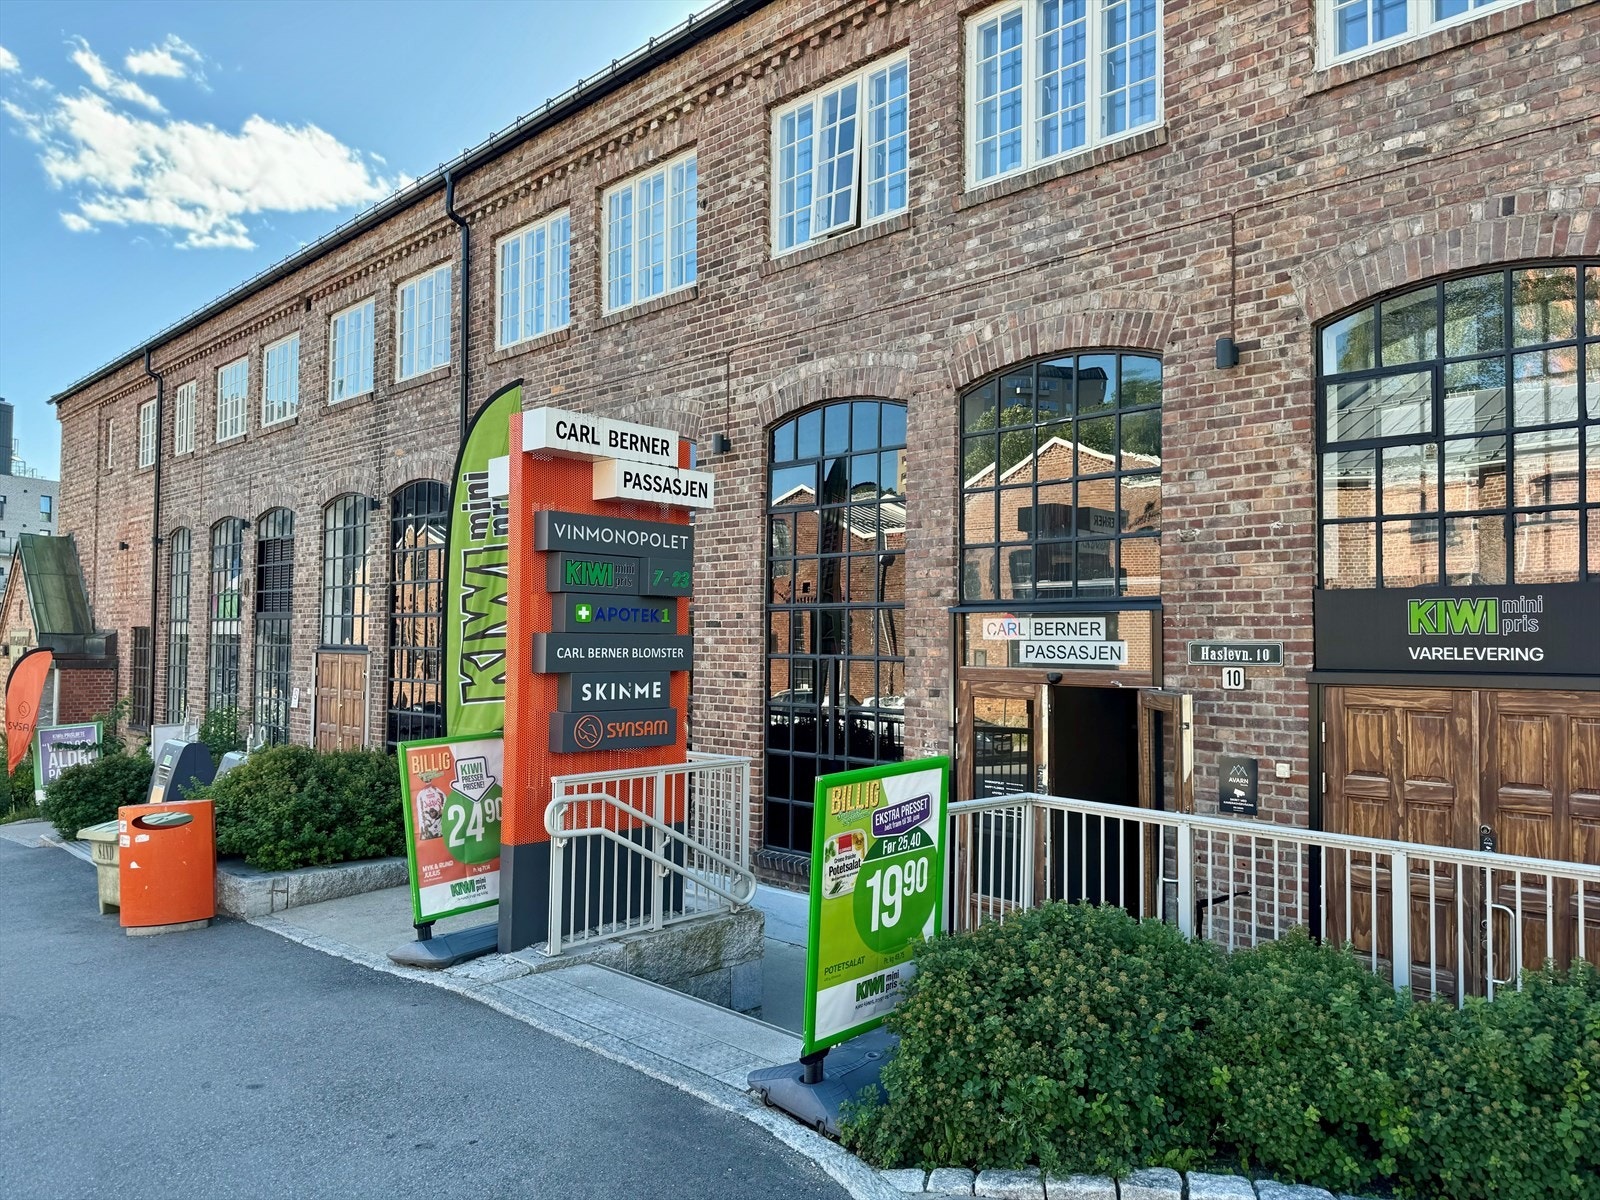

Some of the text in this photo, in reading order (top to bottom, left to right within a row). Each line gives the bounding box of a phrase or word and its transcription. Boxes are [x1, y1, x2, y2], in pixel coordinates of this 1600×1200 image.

[555, 420, 670, 457] CARL BERNER
[623, 471, 708, 499] PASSASJEN
[554, 523, 689, 550] VINMONOPOLET
[565, 559, 614, 587] KIWI
[615, 562, 636, 575] mini
[615, 576, 633, 588] pris
[1501, 595, 1543, 614] mini
[1407, 596, 1500, 636] KIWI
[1502, 615, 1540, 636] pris
[987, 621, 1103, 638] CARL BERNER
[556, 647, 684, 659] CARL BERNER BLOMSTER
[1024, 644, 1122, 661] PASSASJEN
[1200, 646, 1270, 661] Haslevn. 10
[1408, 646, 1545, 662] VARELEVERING
[1226, 669, 1241, 687] 10
[606, 719, 668, 739] SYNSAM
[411, 752, 451, 774] BILLIG
[460, 762, 483, 776] KIWI
[461, 774, 484, 784] PRESSER
[463, 781, 486, 791] PRISENE!
[831, 780, 880, 815] BILLIG
[875, 807, 900, 827] EKSTRA
[901, 798, 928, 818] PRESSET
[447, 802, 486, 848] 24
[883, 832, 921, 855] Før 25,40
[829, 858, 862, 877] Potetsalat
[450, 879, 476, 897] KIWI
[476, 877, 487, 885] mini
[476, 884, 487, 892] pris
[866, 857, 929, 932] 19 90
[824, 956, 866, 976] POTETSALAT
[886, 970, 900, 983] mini
[856, 974, 885, 1003] KIWI
[886, 980, 898, 993] pris
